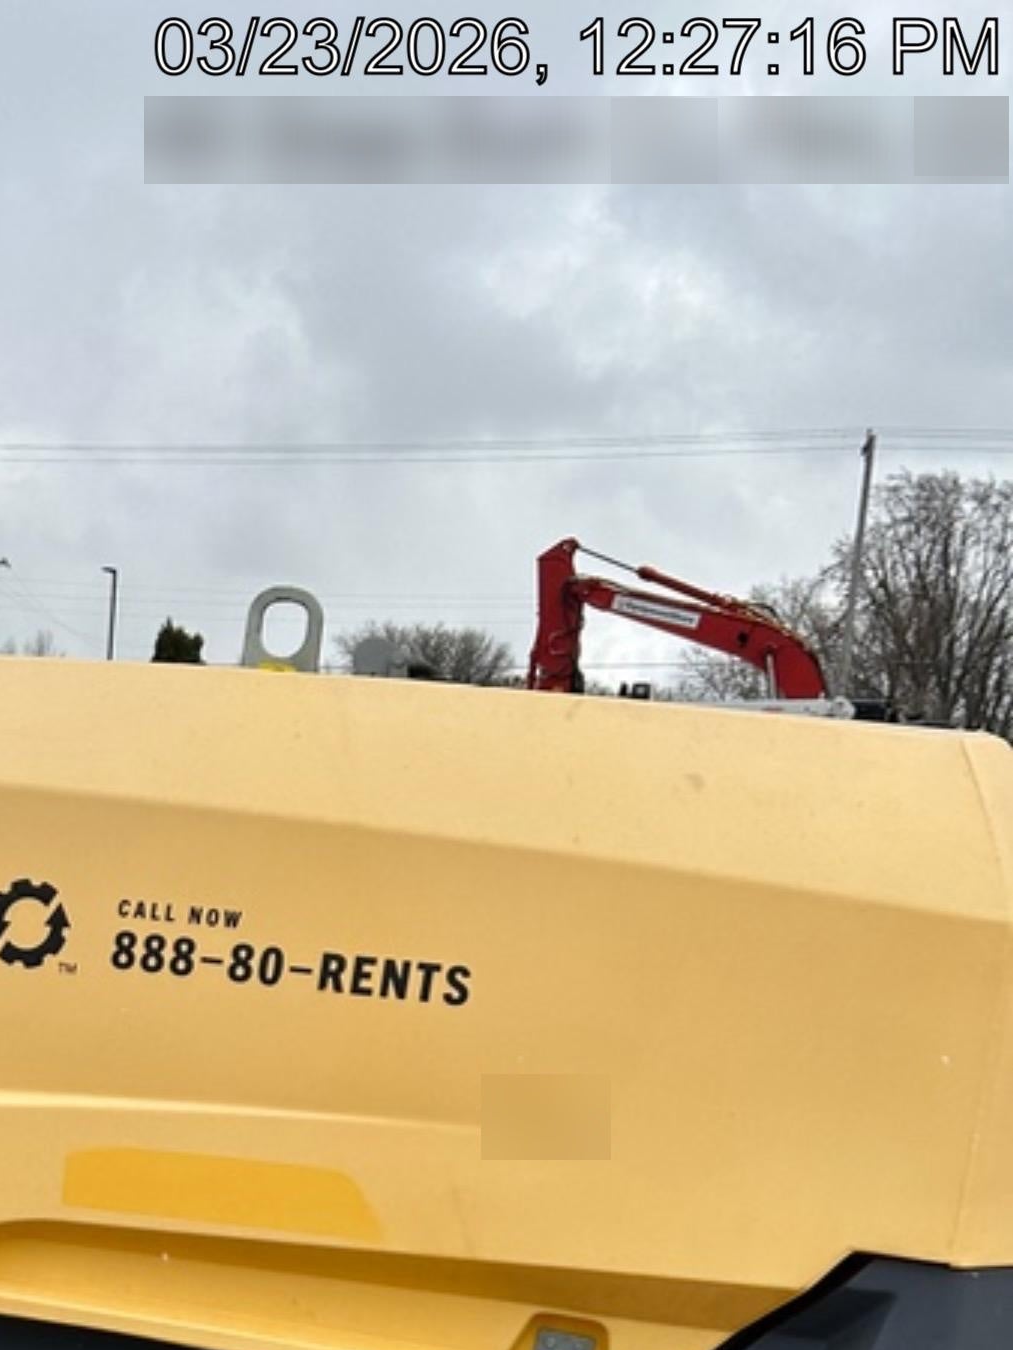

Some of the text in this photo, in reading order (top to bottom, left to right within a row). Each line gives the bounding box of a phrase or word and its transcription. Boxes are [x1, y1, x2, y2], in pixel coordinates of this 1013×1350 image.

[118, 899, 243, 929] CALL NOW
[111, 930, 472, 1006] 888-80-RENTS
